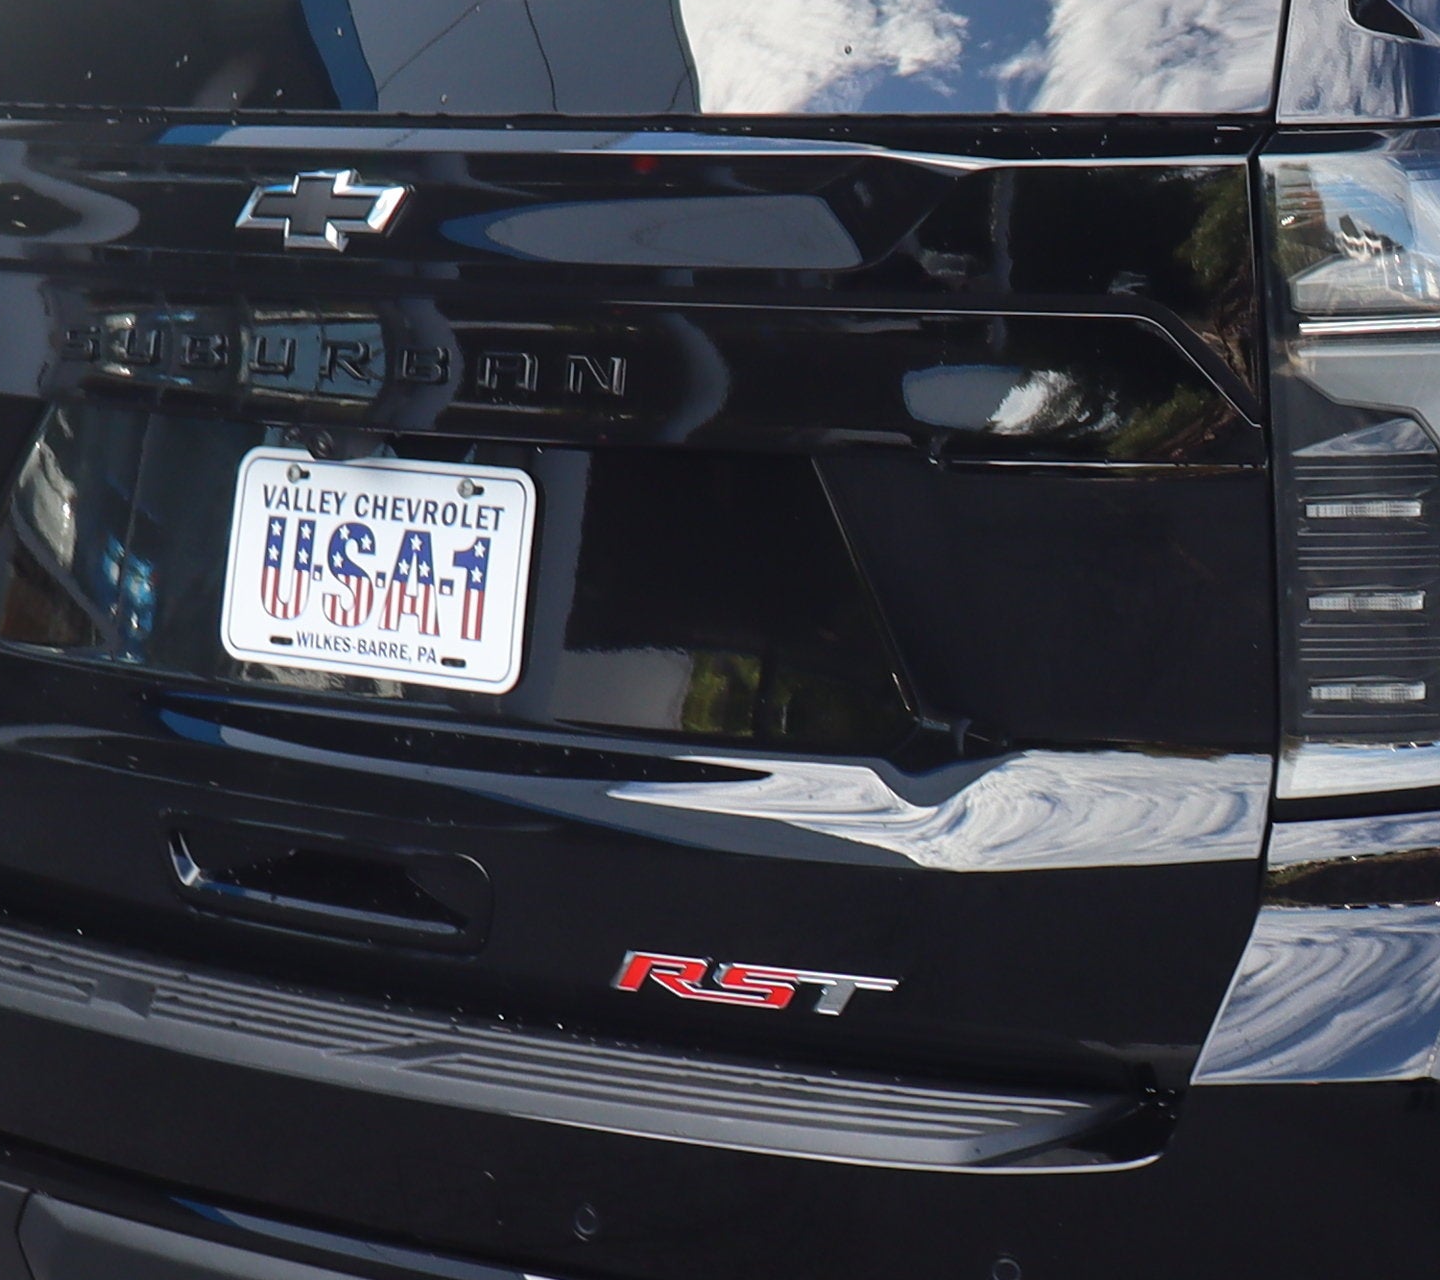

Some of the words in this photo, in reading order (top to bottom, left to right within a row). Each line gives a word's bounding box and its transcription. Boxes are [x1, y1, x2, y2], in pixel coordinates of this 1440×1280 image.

[63, 325, 627, 397] SUBURBAN
[262, 483, 347, 516] VALLEY
[353, 492, 505, 532] CHEVROLET
[295, 630, 414, 664] WILKES-BARRE,
[416, 646, 437, 664] PA
[611, 949, 903, 1017] RST
